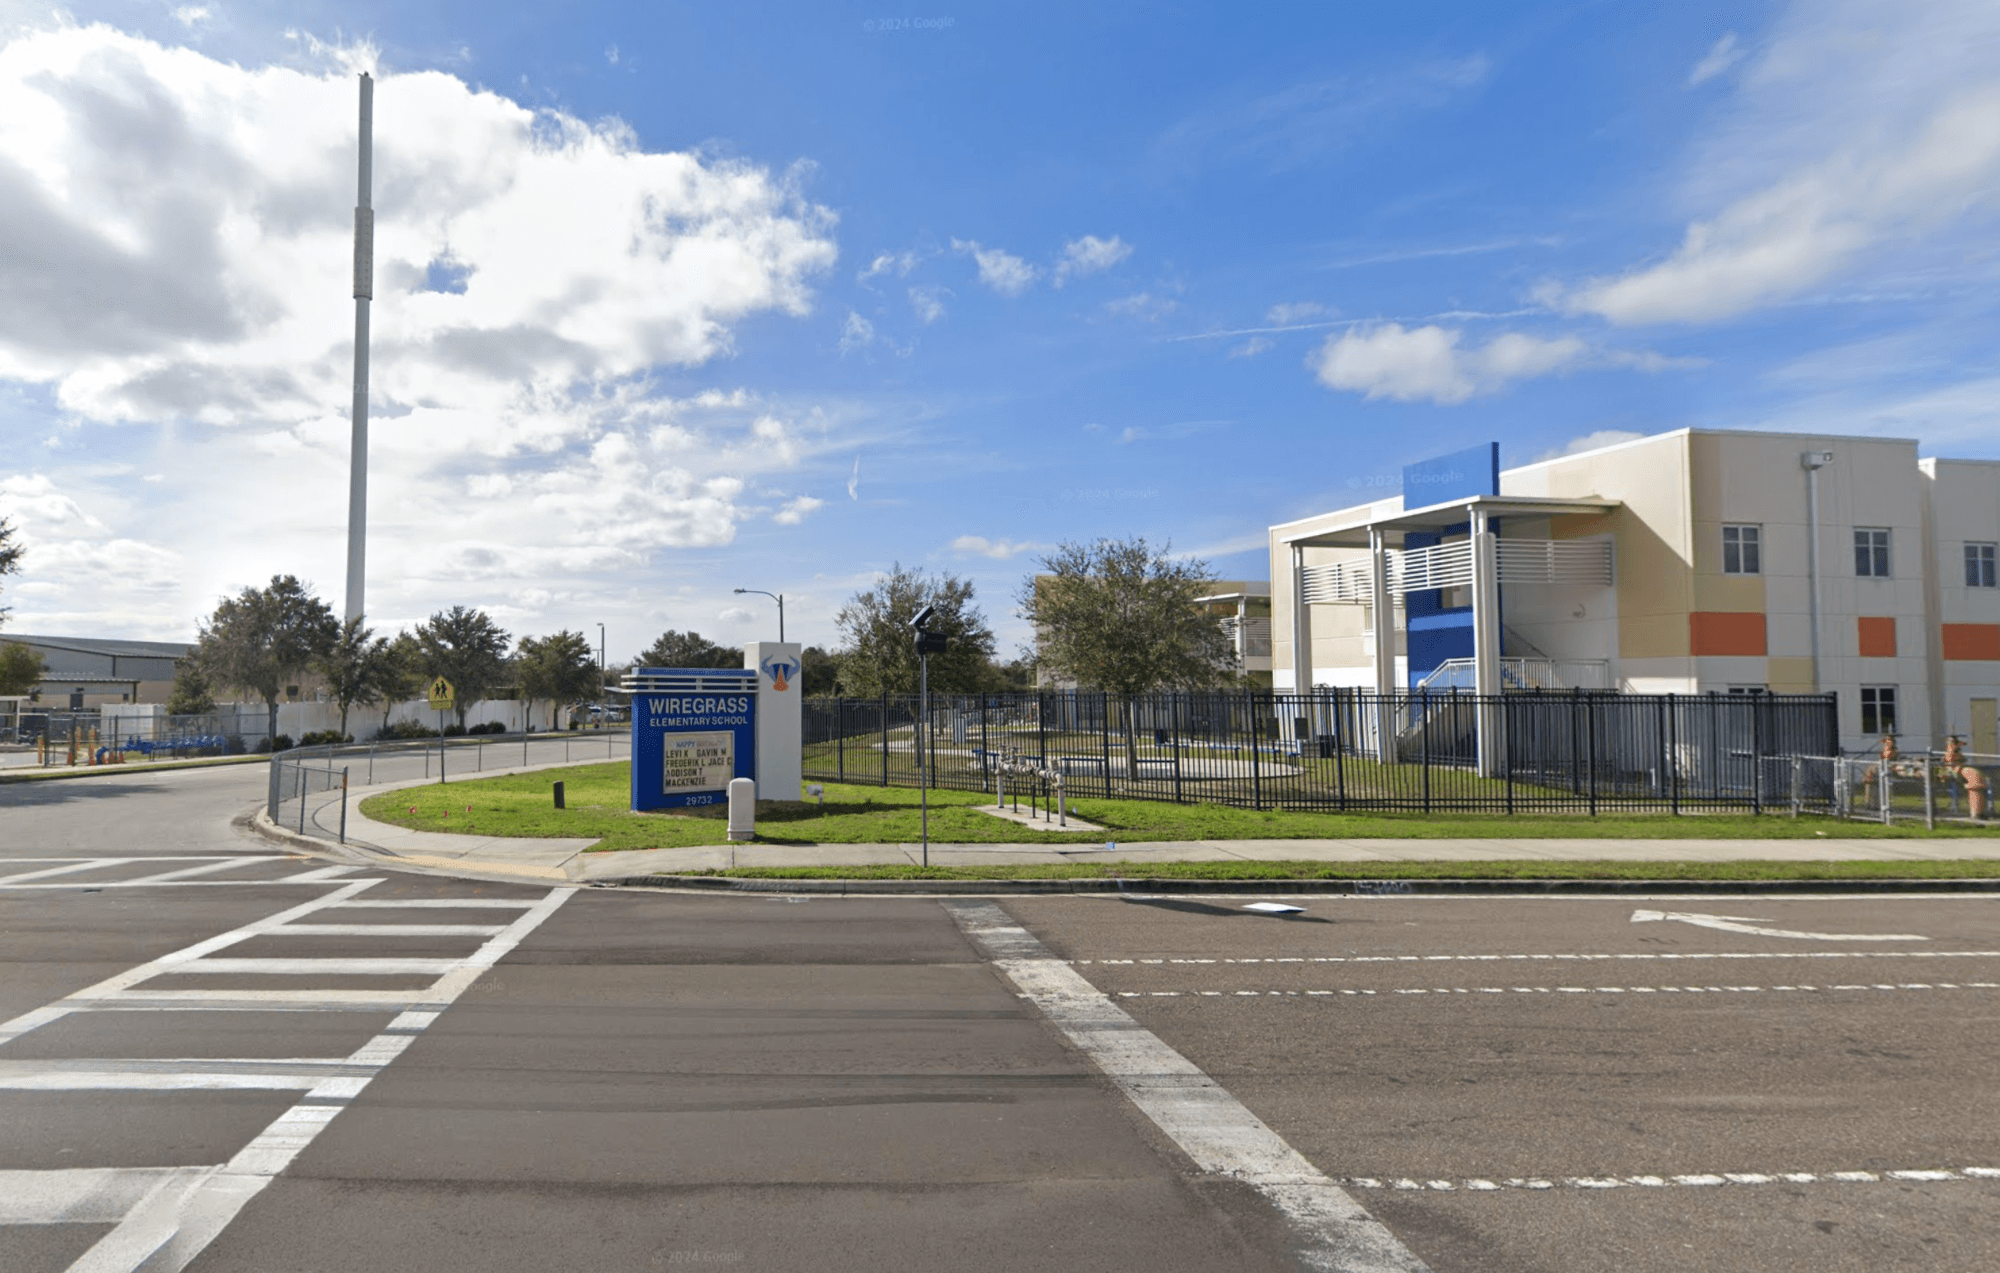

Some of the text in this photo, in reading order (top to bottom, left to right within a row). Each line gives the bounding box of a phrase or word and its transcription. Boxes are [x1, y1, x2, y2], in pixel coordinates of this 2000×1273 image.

[648, 697, 748, 715] WIREGRASS
[650, 716, 748, 727] ELEMENTARY SCHOOL
[676, 740, 696, 748] HAPPY
[666, 750, 682, 759] LEVI
[684, 750, 689, 758] K
[696, 749, 718, 758] GAVIN
[666, 758, 700, 768] FREDERIK
[701, 758, 706, 767] L
[708, 757, 725, 766] JACE
[698, 767, 703, 776] T
[666, 777, 706, 787] MACKENZIE
[686, 795, 712, 806] 29732
